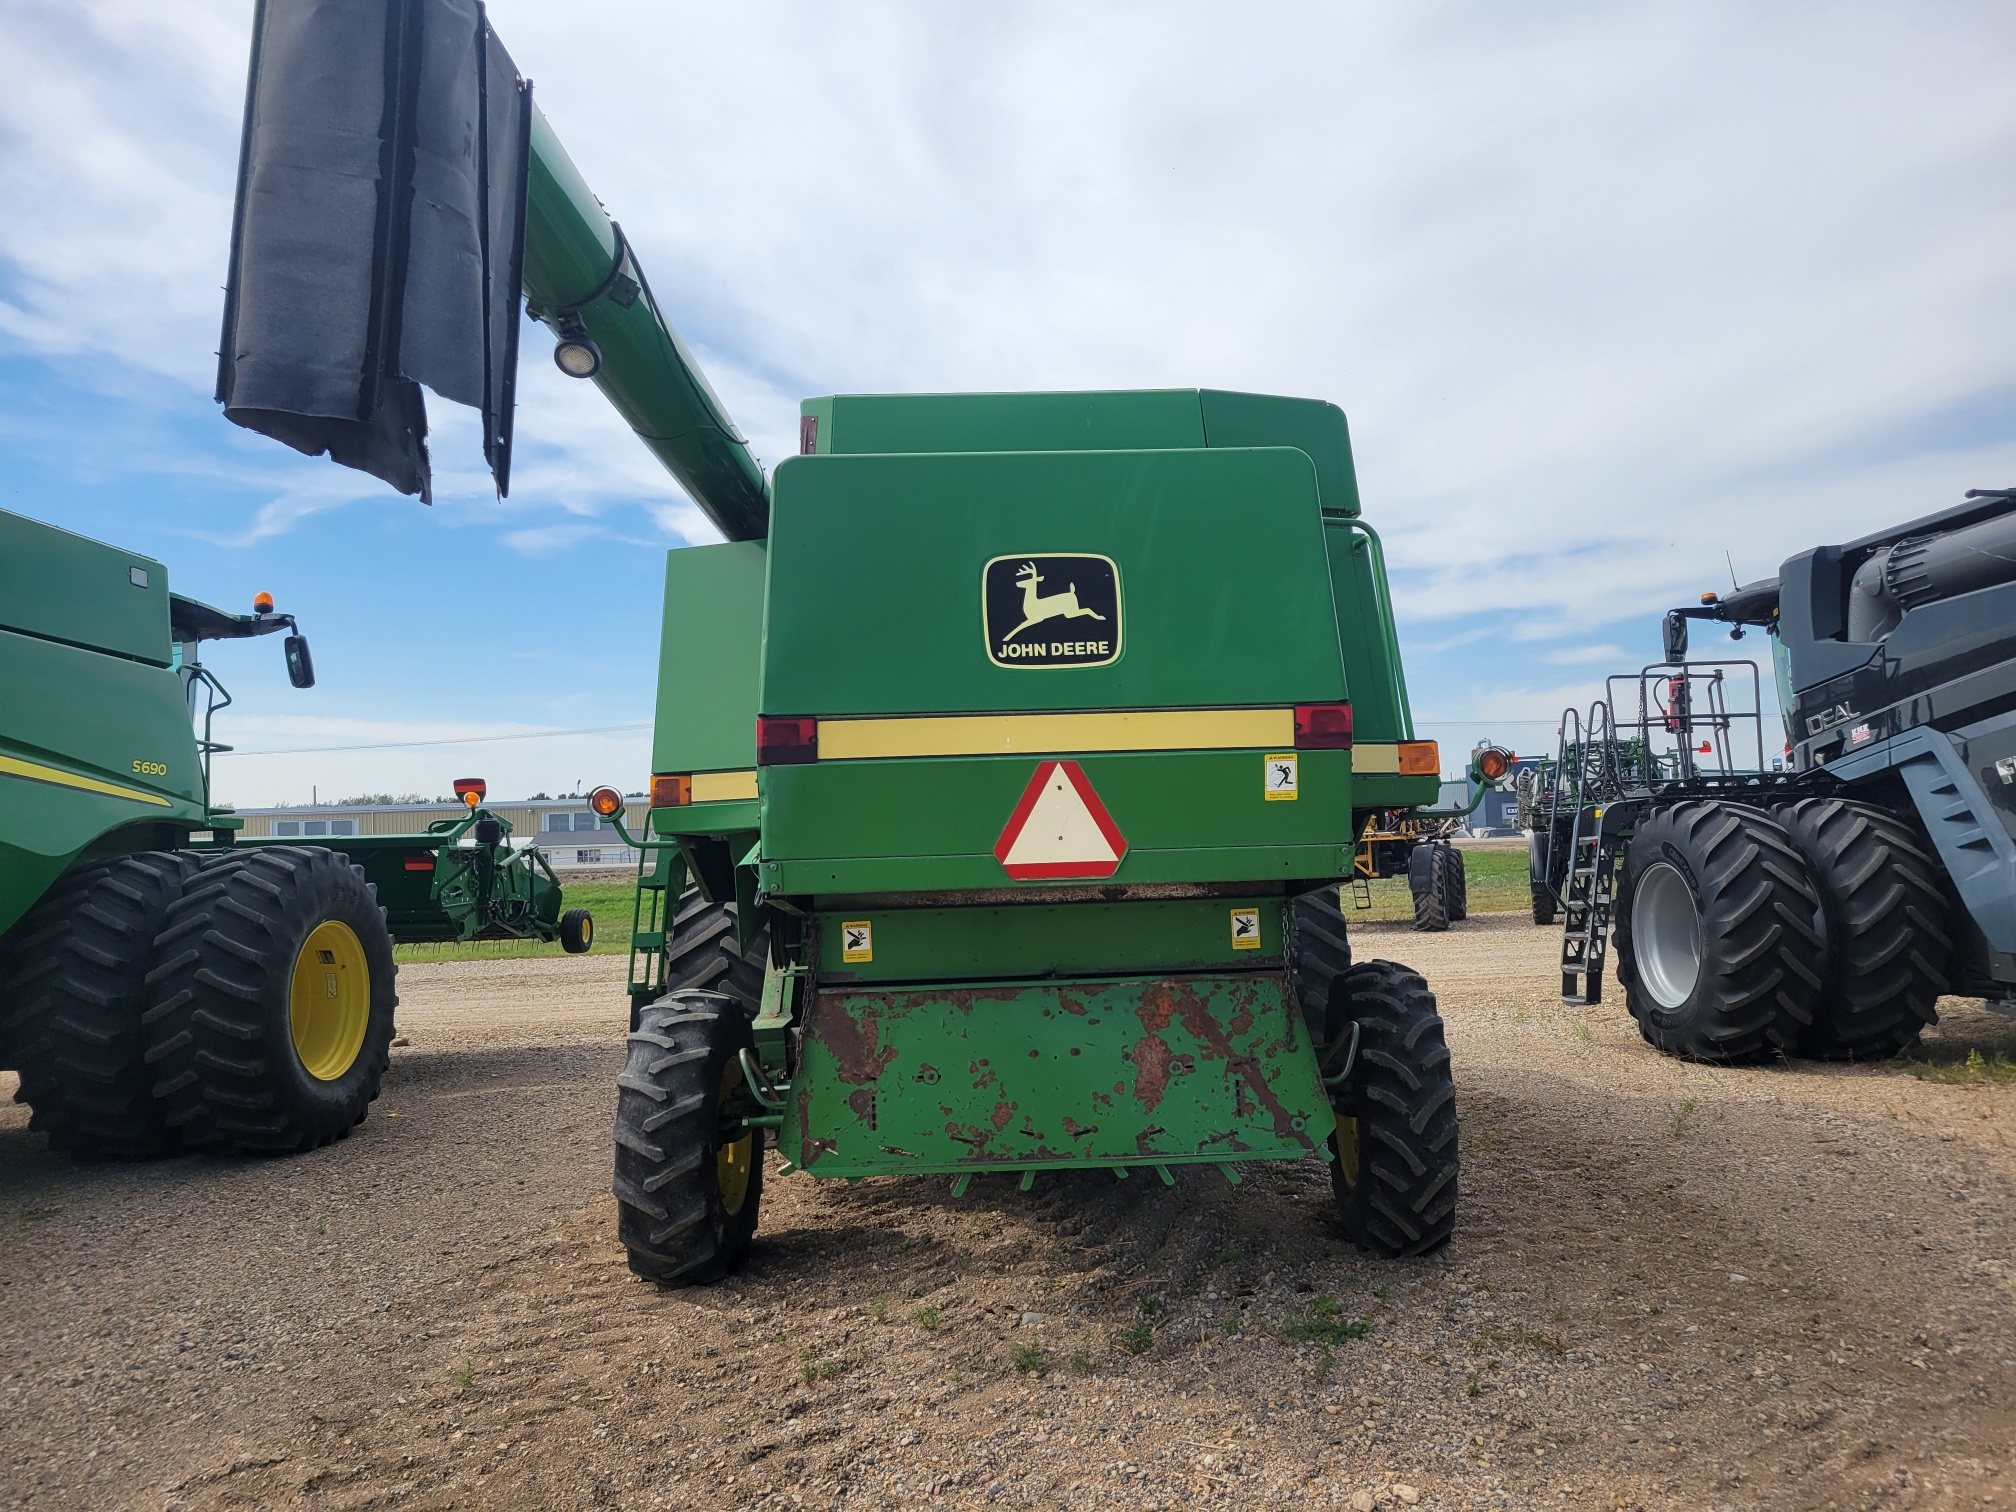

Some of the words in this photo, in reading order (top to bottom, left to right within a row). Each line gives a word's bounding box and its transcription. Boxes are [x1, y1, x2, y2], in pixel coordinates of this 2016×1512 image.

[998, 643, 1046, 658] JOHN
[1051, 641, 1109, 656] DEERE
[1805, 701, 1860, 736] IDEAL
[132, 760, 167, 776] S690
